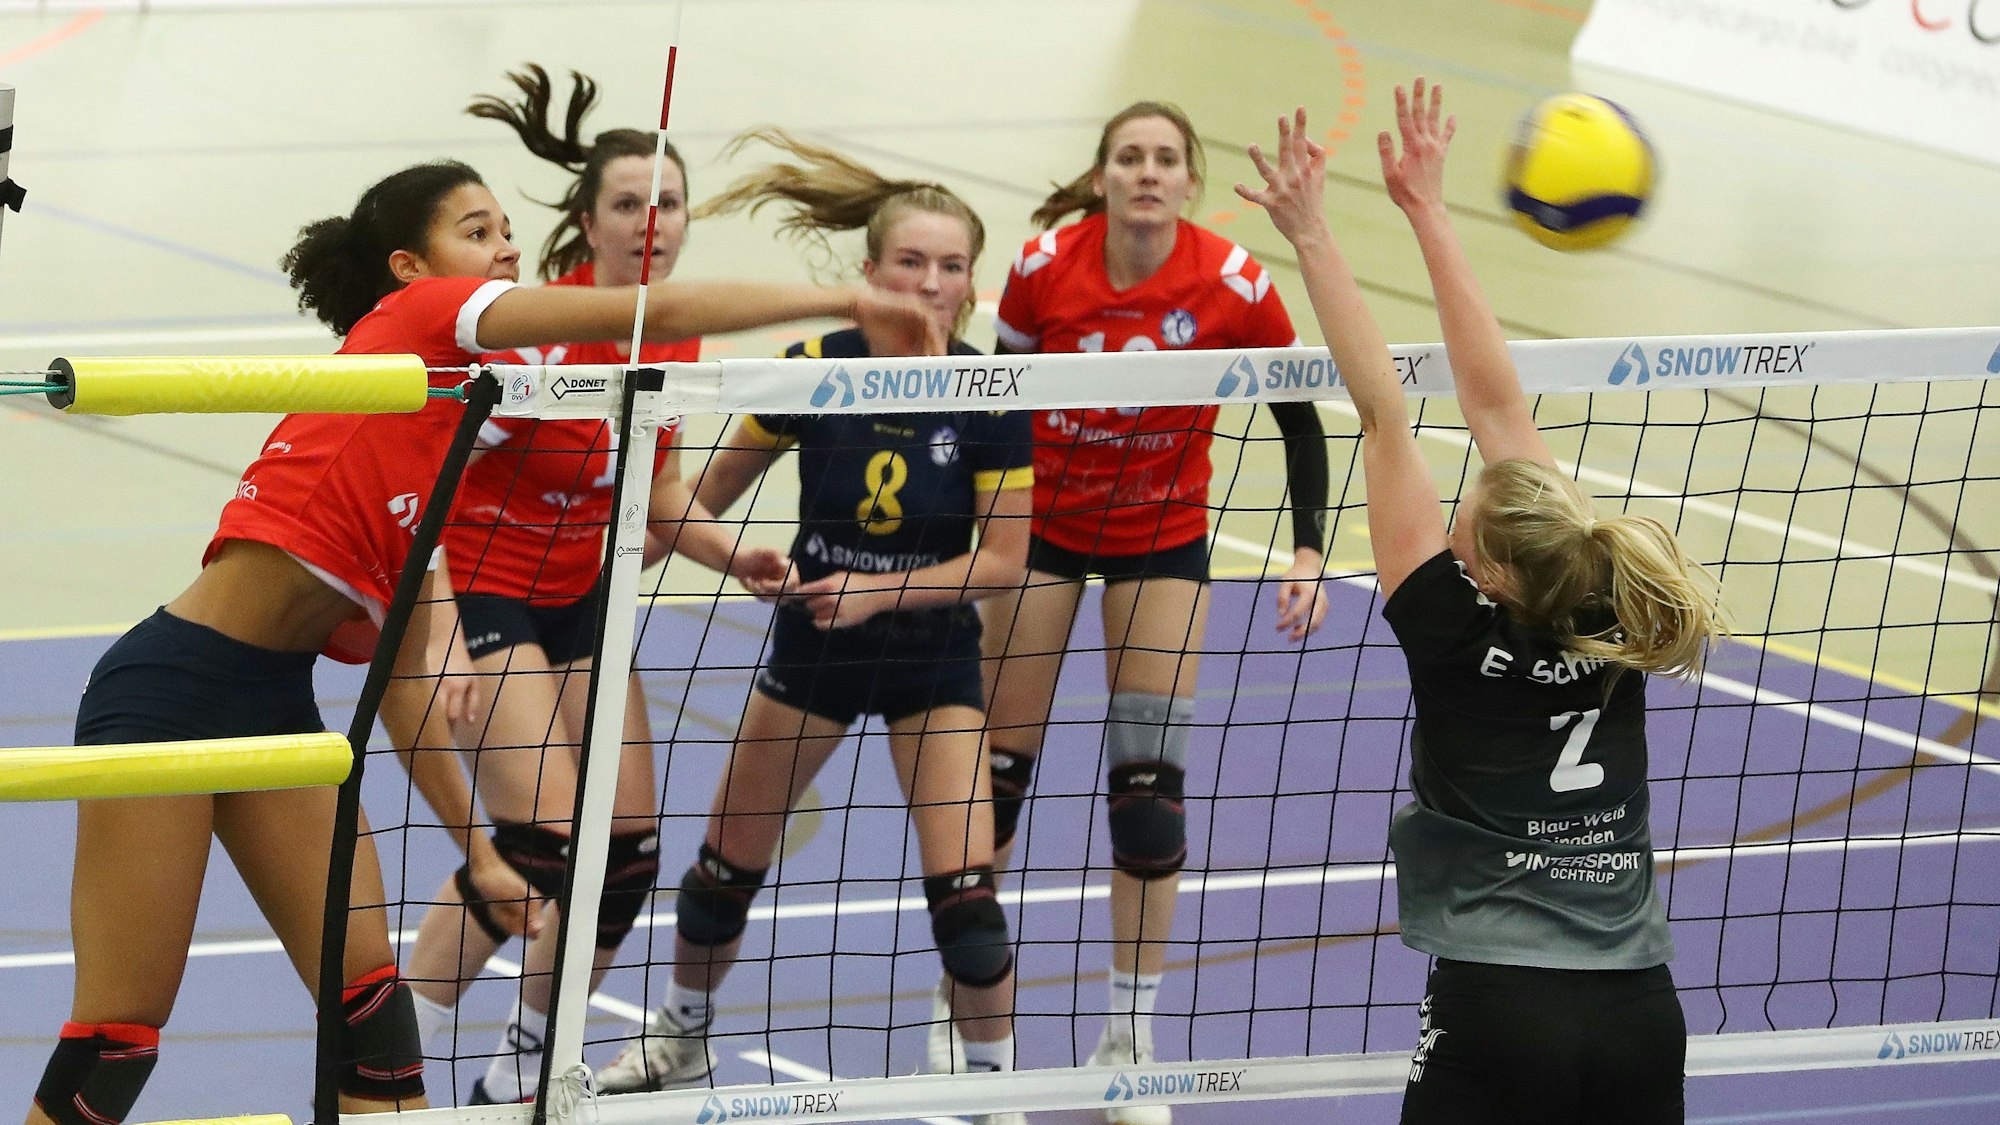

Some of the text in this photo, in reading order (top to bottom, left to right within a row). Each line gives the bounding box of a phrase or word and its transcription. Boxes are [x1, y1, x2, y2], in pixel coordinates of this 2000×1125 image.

[570, 379, 607, 388] DONET
[856, 450, 908, 536] 8
[1550, 708, 1604, 793] 2
[1527, 804, 1626, 837] Blau-Weiß
[1525, 852, 1640, 871] INTERSPORT
[1550, 868, 1616, 884] OCHTRUP
